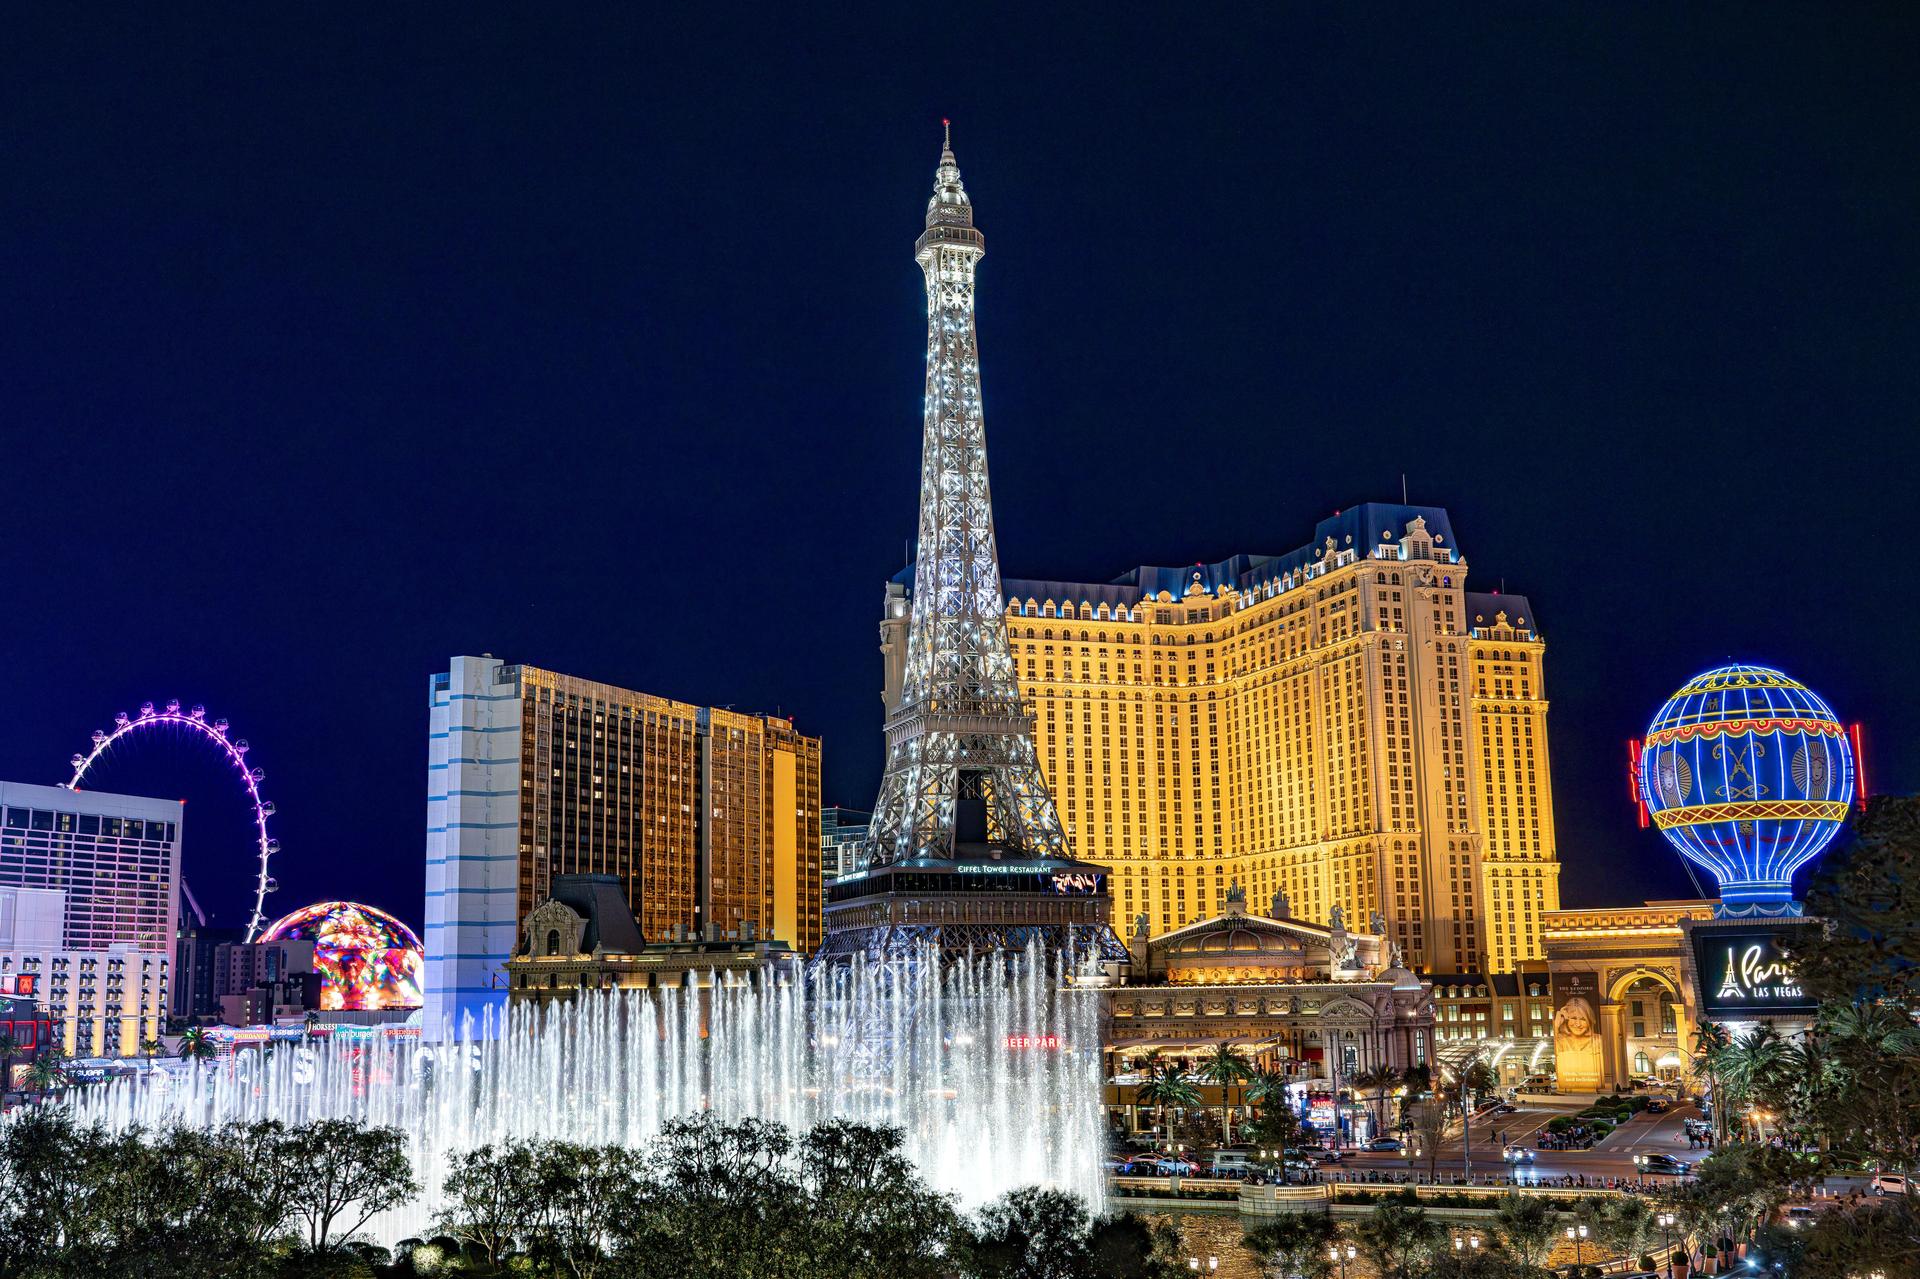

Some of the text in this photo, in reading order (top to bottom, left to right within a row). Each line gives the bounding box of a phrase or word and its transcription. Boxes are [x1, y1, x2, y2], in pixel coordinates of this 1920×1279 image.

[957, 865, 1052, 873] EIFFEL TOWER RESTAURANT
[1753, 986, 1803, 998] LAS VEGAS
[1003, 1038, 1062, 1048] BEER PARK
